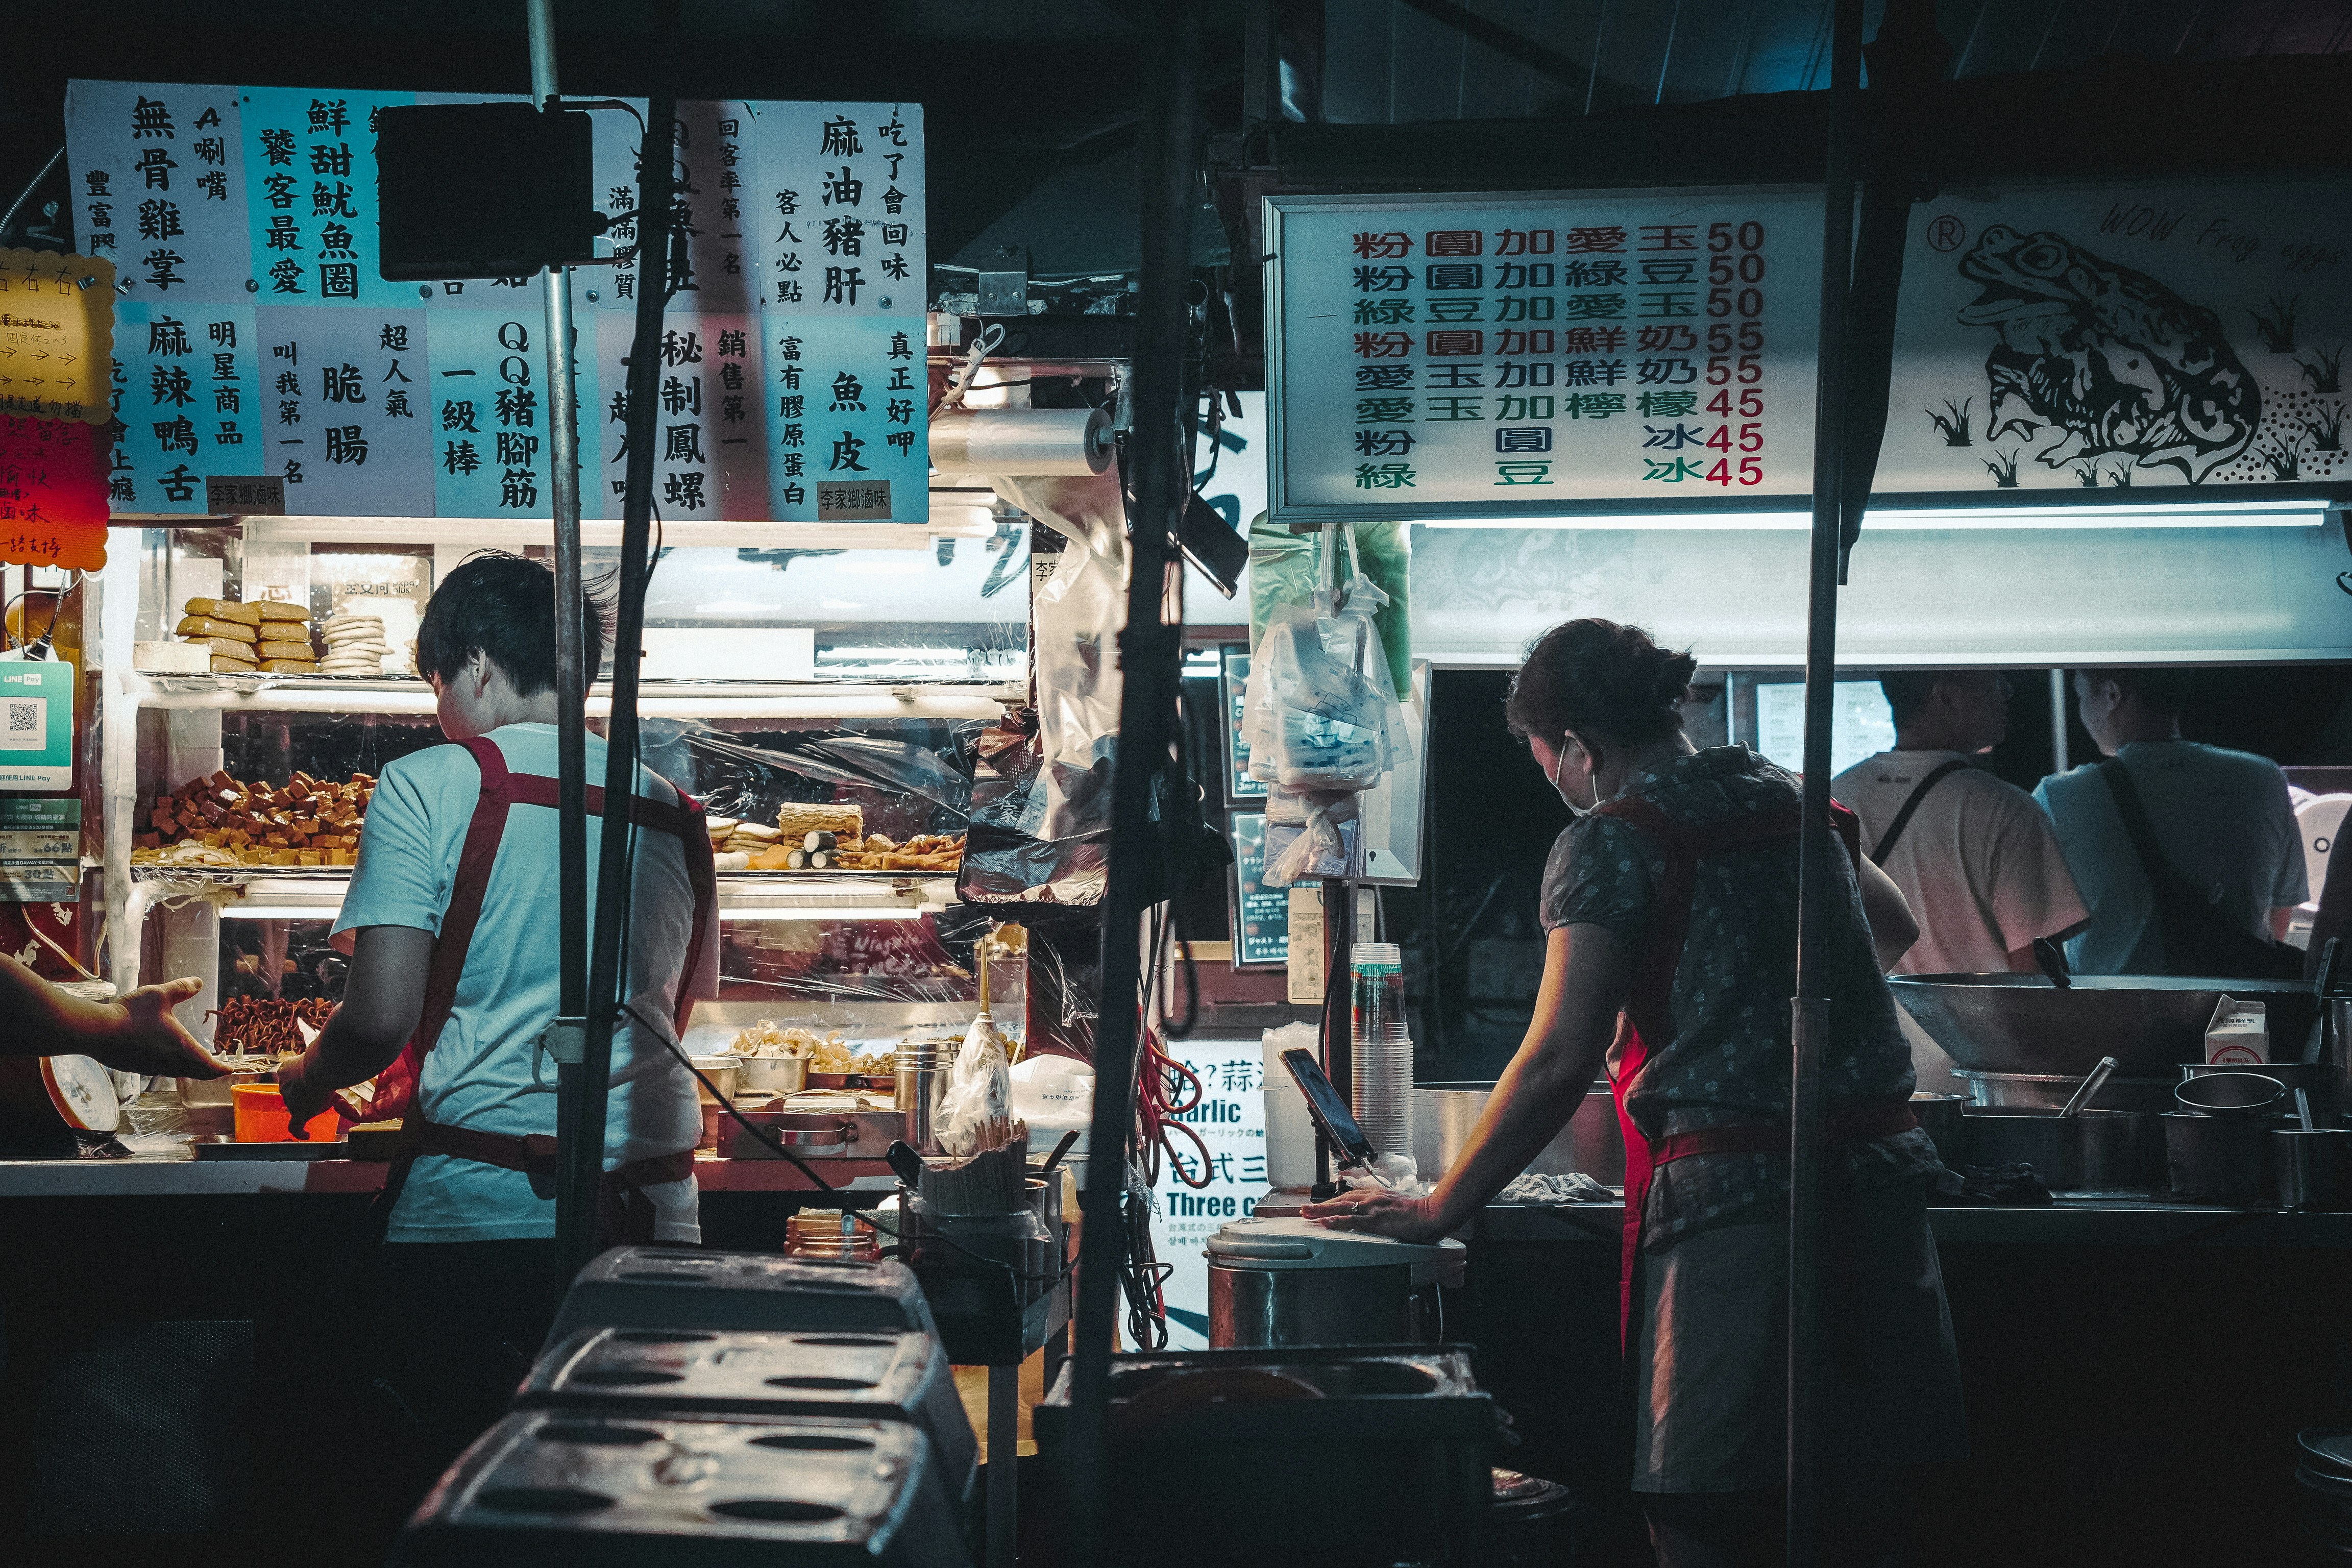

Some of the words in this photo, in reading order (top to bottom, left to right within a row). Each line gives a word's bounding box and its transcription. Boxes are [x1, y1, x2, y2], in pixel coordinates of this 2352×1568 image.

[130, 95, 186, 292] 無骨雞掌
[192, 106, 228, 201] A唰嘴
[306, 98, 360, 300] 鮮甜魷魚圈
[717, 118, 743, 275] 回客率第一名
[875, 117, 912, 282] 吃了會回味
[257, 128, 309, 294] 饕客最愛
[607, 185, 638, 301] 滿滿膠質
[775, 188, 803, 304] 客人必點
[818, 114, 868, 307] 麻油豬肝
[1352, 225, 1699, 259] 粉圓加愛玉
[1706, 221, 1765, 253] 50
[2100, 202, 2187, 243] WOW
[2196, 217, 2262, 263] Frog
[1352, 260, 1699, 290] 粉圓加綠豆
[1706, 254, 1765, 285] 50
[1353, 292, 1699, 324] 綠豆加愛玉
[1706, 288, 1765, 318] 50
[208, 320, 243, 446] 明星商品
[379, 323, 414, 419] 超人氣
[717, 329, 747, 444] 銷售第一
[886, 330, 916, 458] 真正好呷
[1353, 326, 1699, 358] 粉圓加鮮奶
[1706, 322, 1765, 353] 55
[1355, 360, 1699, 390] 愛玉加鮮奶
[1705, 355, 1764, 385] 55
[147, 314, 202, 503] 麻辣鴨舌
[272, 341, 304, 485] 叫我第一名
[322, 362, 369, 467] 脆腸
[441, 368, 484, 477] 一級棒
[494, 321, 539, 509] QQ豬腳筋
[660, 329, 706, 511] 秘制鳳螺
[778, 335, 807, 505] 富有膠原蛋白
[827, 370, 870, 473] 魚皮
[1354, 423, 1705, 456] 粉圓冰
[1705, 423, 1764, 453] 45
[1355, 391, 1699, 423] 愛玉加檸檬
[1705, 388, 1764, 419] 45
[820, 486, 888, 510] 李家鄉滷味
[1355, 457, 1705, 489] 綠豆冰
[1705, 456, 1764, 487] 45
[1170, 1099, 1241, 1122] Garlic
[1167, 1192, 1236, 1217] Three
[1243, 1196, 1263, 1217] c
